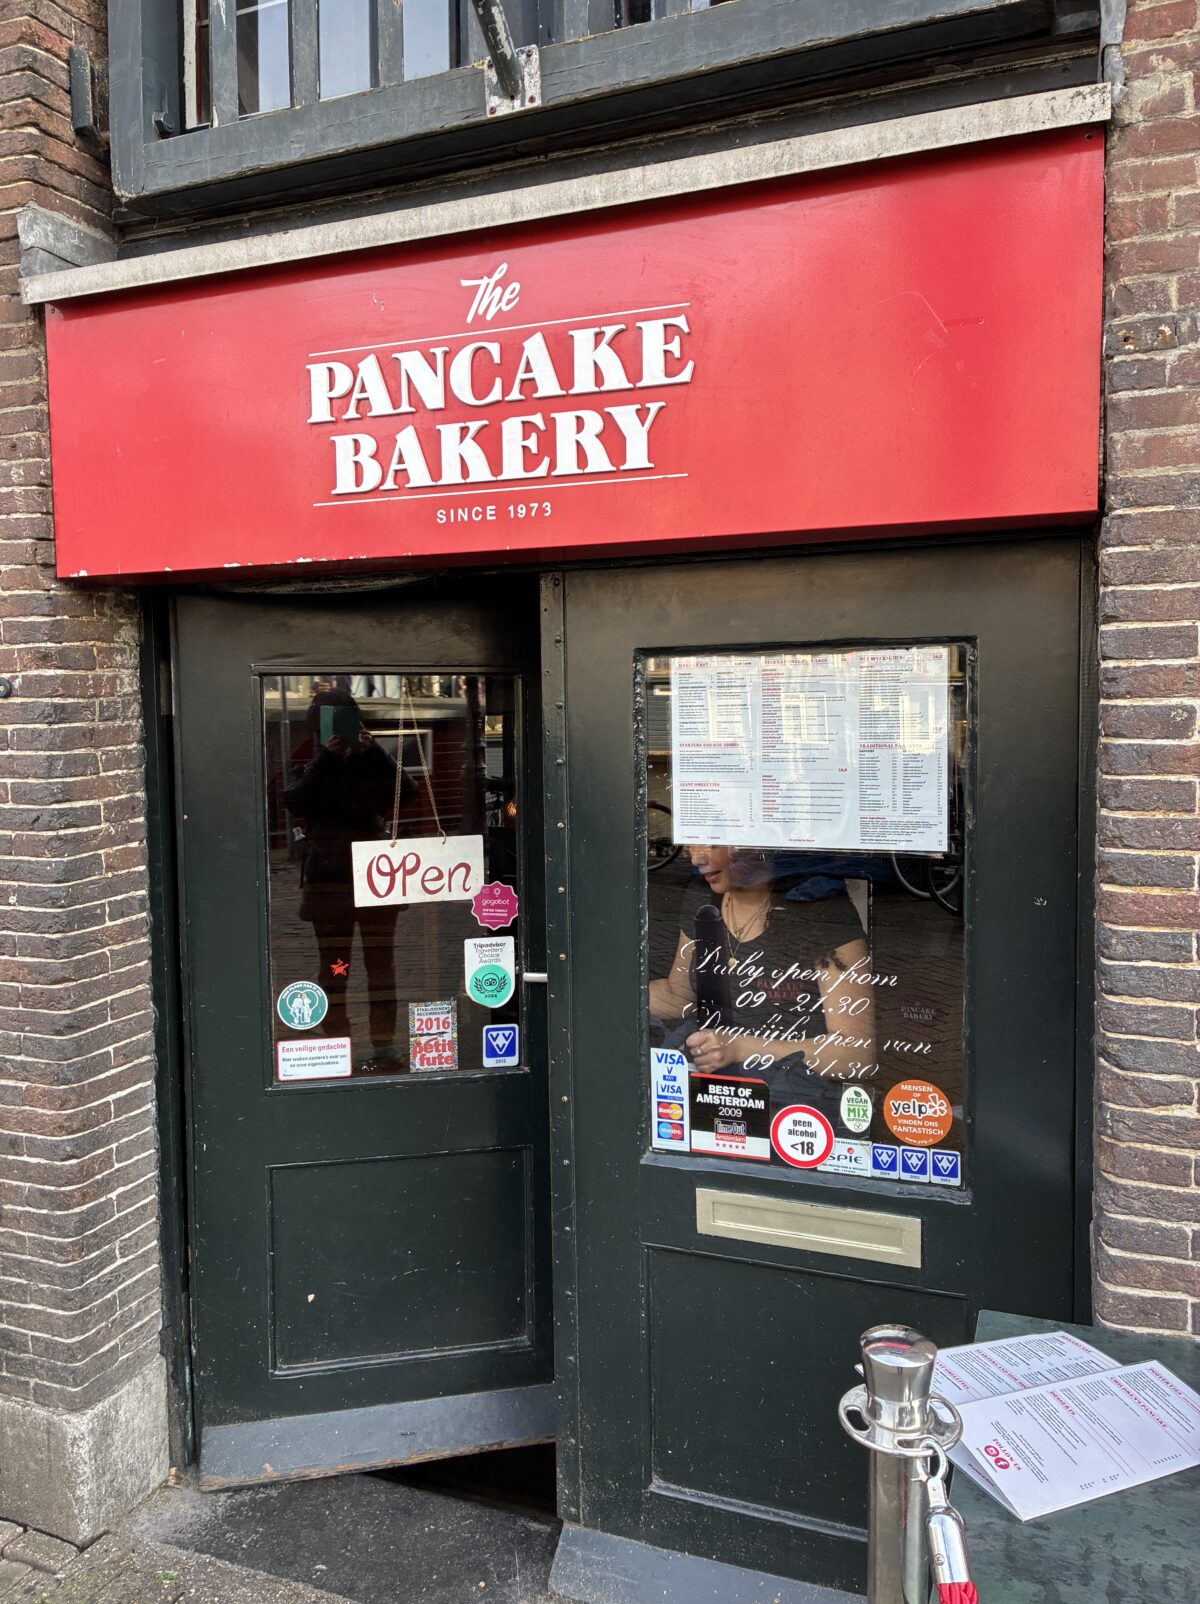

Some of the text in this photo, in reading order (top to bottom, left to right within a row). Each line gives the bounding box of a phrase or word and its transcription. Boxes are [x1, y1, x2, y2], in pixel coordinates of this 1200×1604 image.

[460, 263, 520, 323] The
[306, 314, 695, 425] PANCAKE
[330, 401, 667, 496] BAKERY
[436, 502, 553, 523] SINCE 1973
[473, 941, 506, 949] Tripadvisor
[677, 939, 898, 993] Daily open from
[735, 991, 767, 1008] 09
[789, 993, 870, 1016] 21.30
[416, 1016, 451, 1032] 2016
[317, 1042, 347, 1051] gedachte
[411, 1038, 454, 1060] petit
[813, 1029, 872, 1055] open
[656, 1052, 685, 1066] VISA
[743, 1053, 775, 1071] 09
[666, 1066, 674, 1075] V
[660, 1083, 682, 1095] VISA
[709, 1085, 752, 1098] BEST OF
[901, 1084, 933, 1092] MENSEN
[696, 1093, 765, 1110] AMSTERDAM
[846, 1097, 868, 1105] VEGAN
[891, 1099, 929, 1118] yelp
[718, 1106, 742, 1118] 2009
[847, 1107, 869, 1119] MIX
[792, 1119, 812, 1128] geen
[897, 1118, 922, 1126] VINDEN
[787, 1128, 817, 1139] alcohol
[893, 1125, 944, 1136] FANTASTISCH
[828, 1150, 864, 1165] SPIE
[1050, 1390, 1076, 1416] DESSERTS
[1140, 1403, 1168, 1428] PANCAKE
[993, 1438, 1014, 1462] FOLLOW
